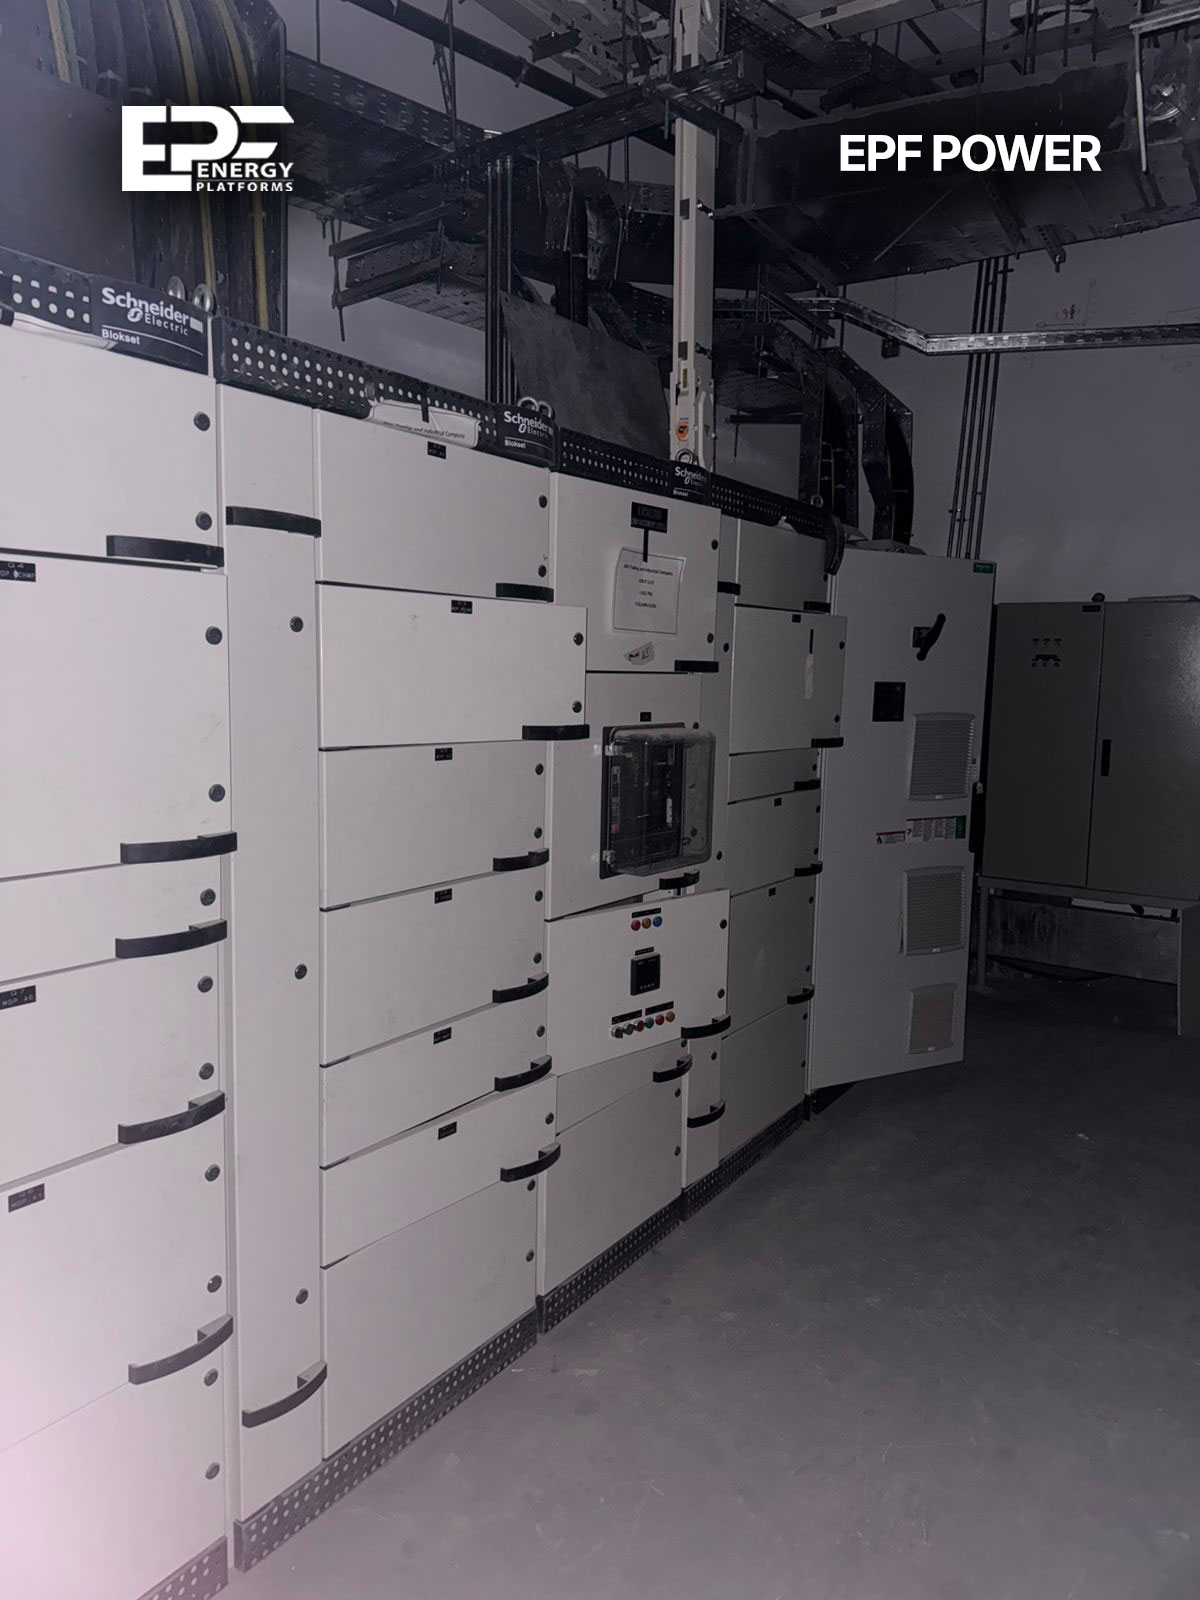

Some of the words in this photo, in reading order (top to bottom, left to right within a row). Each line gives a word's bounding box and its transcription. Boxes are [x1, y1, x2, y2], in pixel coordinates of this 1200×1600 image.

[102, 287, 189, 326] Schneider
[144, 313, 188, 336] Electric
[102, 329, 140, 345] Blokset
[504, 411, 548, 432] Schneider
